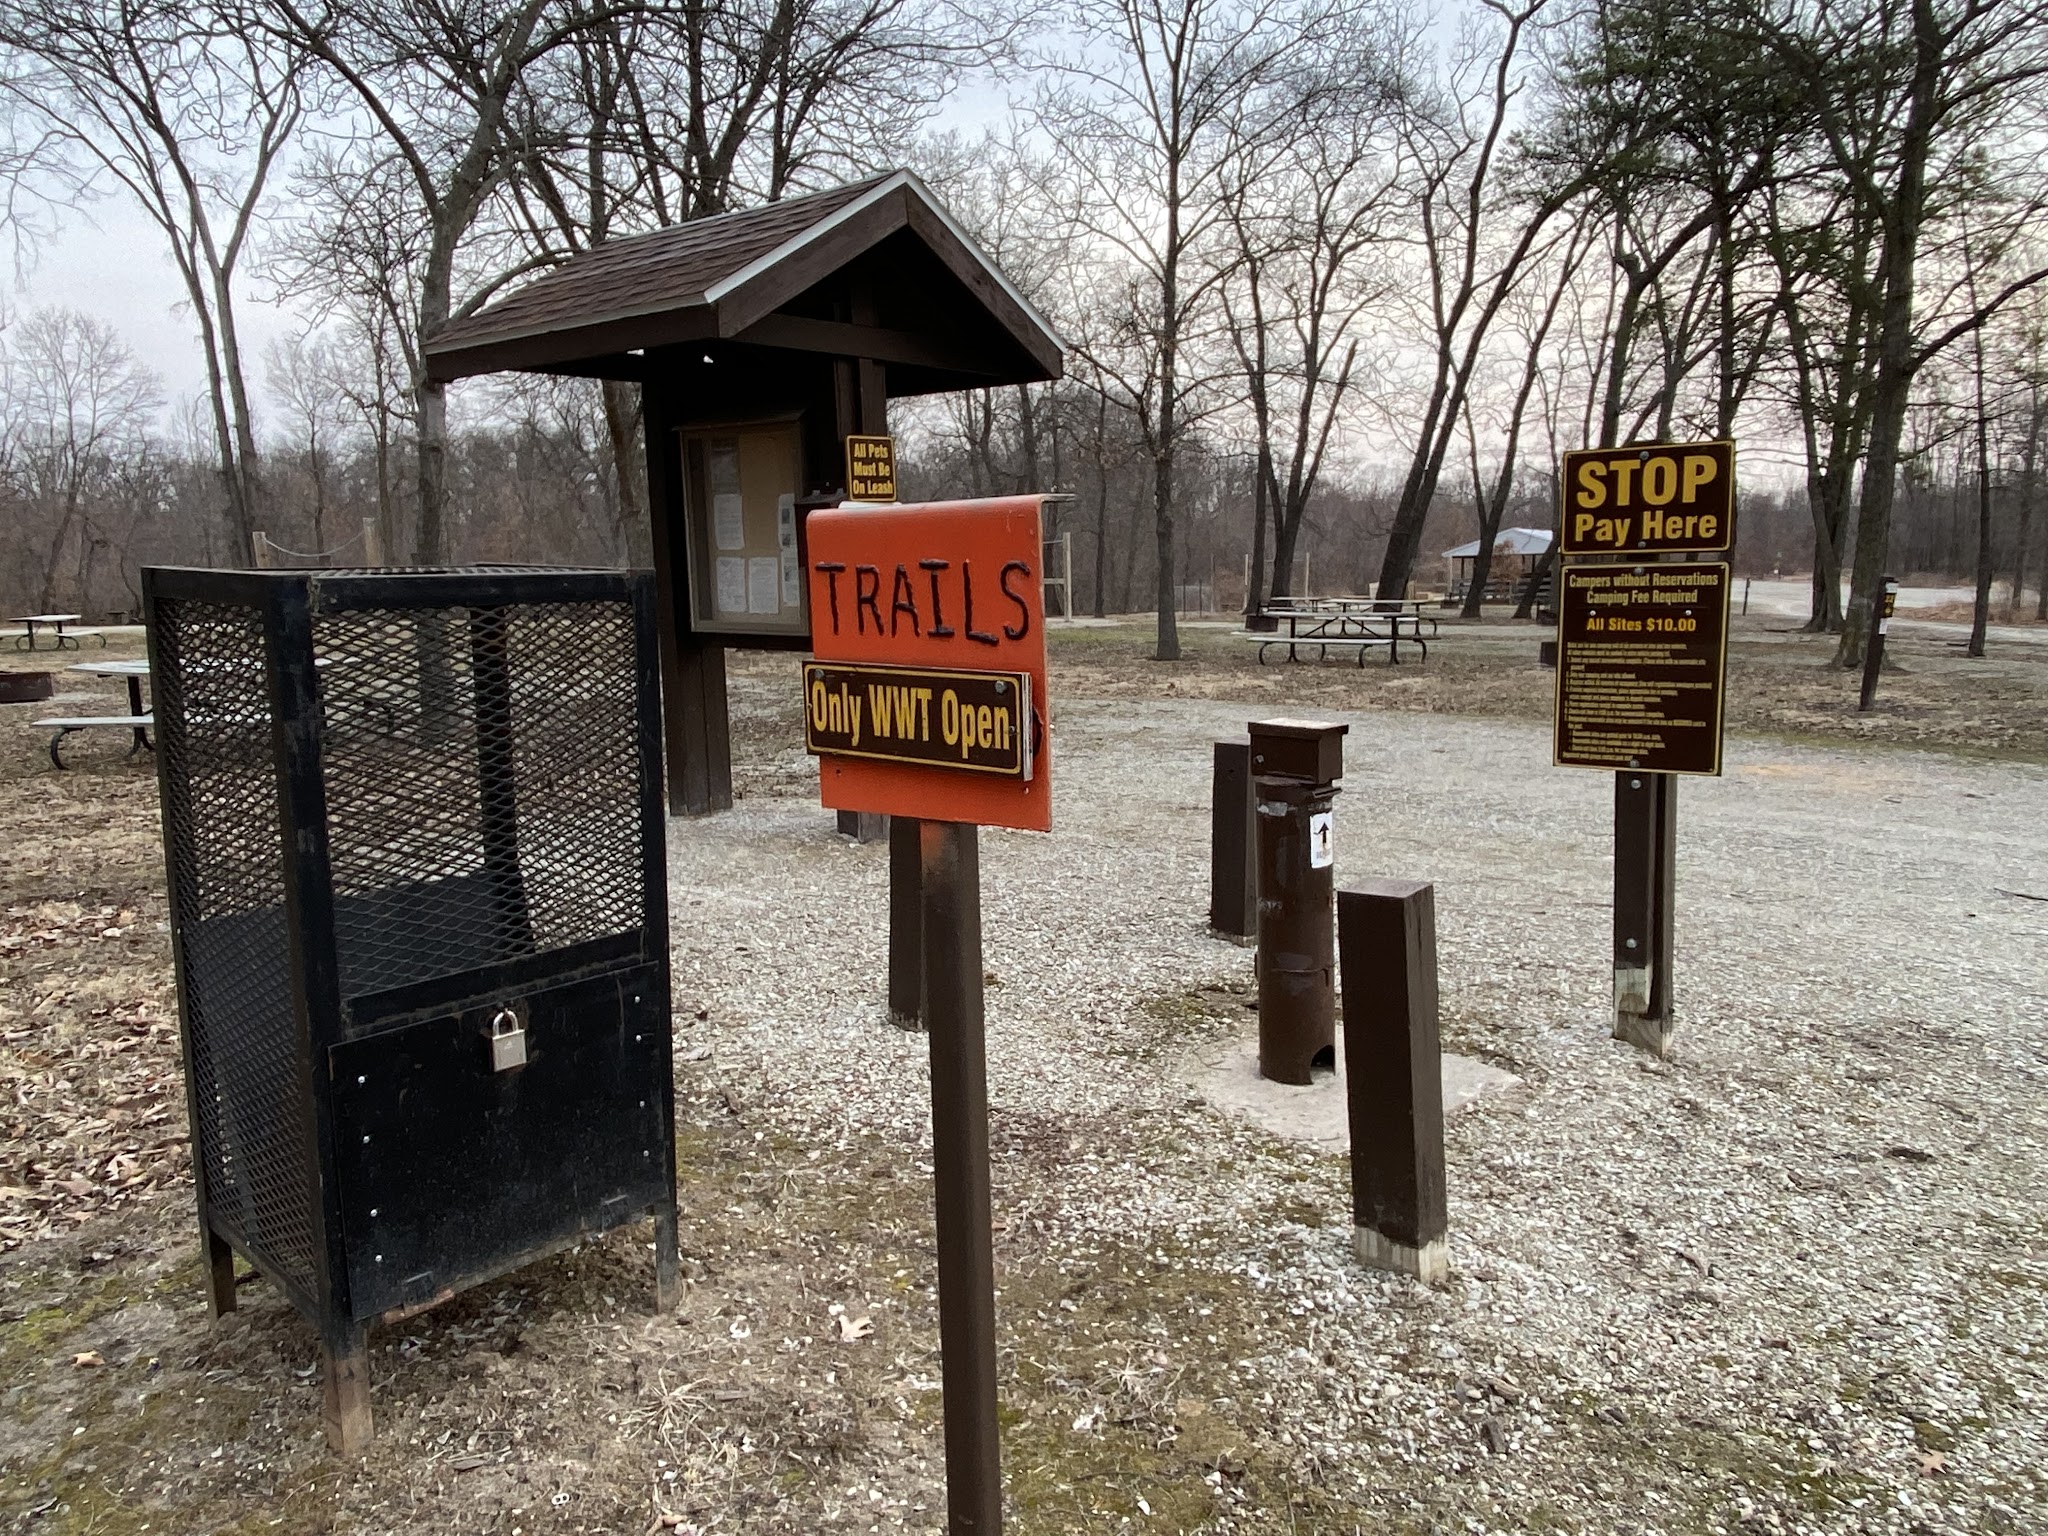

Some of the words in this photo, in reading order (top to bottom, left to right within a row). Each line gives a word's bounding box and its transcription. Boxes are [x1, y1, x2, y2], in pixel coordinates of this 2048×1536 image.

[854, 443, 866, 458] All
[868, 443, 888, 458] Pets
[853, 461, 877, 476] Must
[878, 461, 890, 476] Be
[852, 480, 866, 494] On
[868, 480, 893, 494] Leash
[1577, 455, 1718, 508] STOP
[1575, 513, 1631, 547] Pay
[1642, 510, 1717, 540] Here
[1569, 574, 1611, 589] Campers
[1613, 573, 1650, 586] without
[1652, 572, 1719, 586] Reservations
[815, 558, 1031, 646] TRAILS
[1587, 590, 1629, 606] Camping
[1631, 590, 1649, 603] Fee
[1652, 589, 1698, 605] Required
[1586, 618, 1605, 631] All
[1608, 618, 1643, 631] Sites
[1646, 617, 1697, 632] $10.00
[812, 680, 861, 747] Only
[868, 684, 932, 741] WWT
[941, 689, 1010, 759] Open
